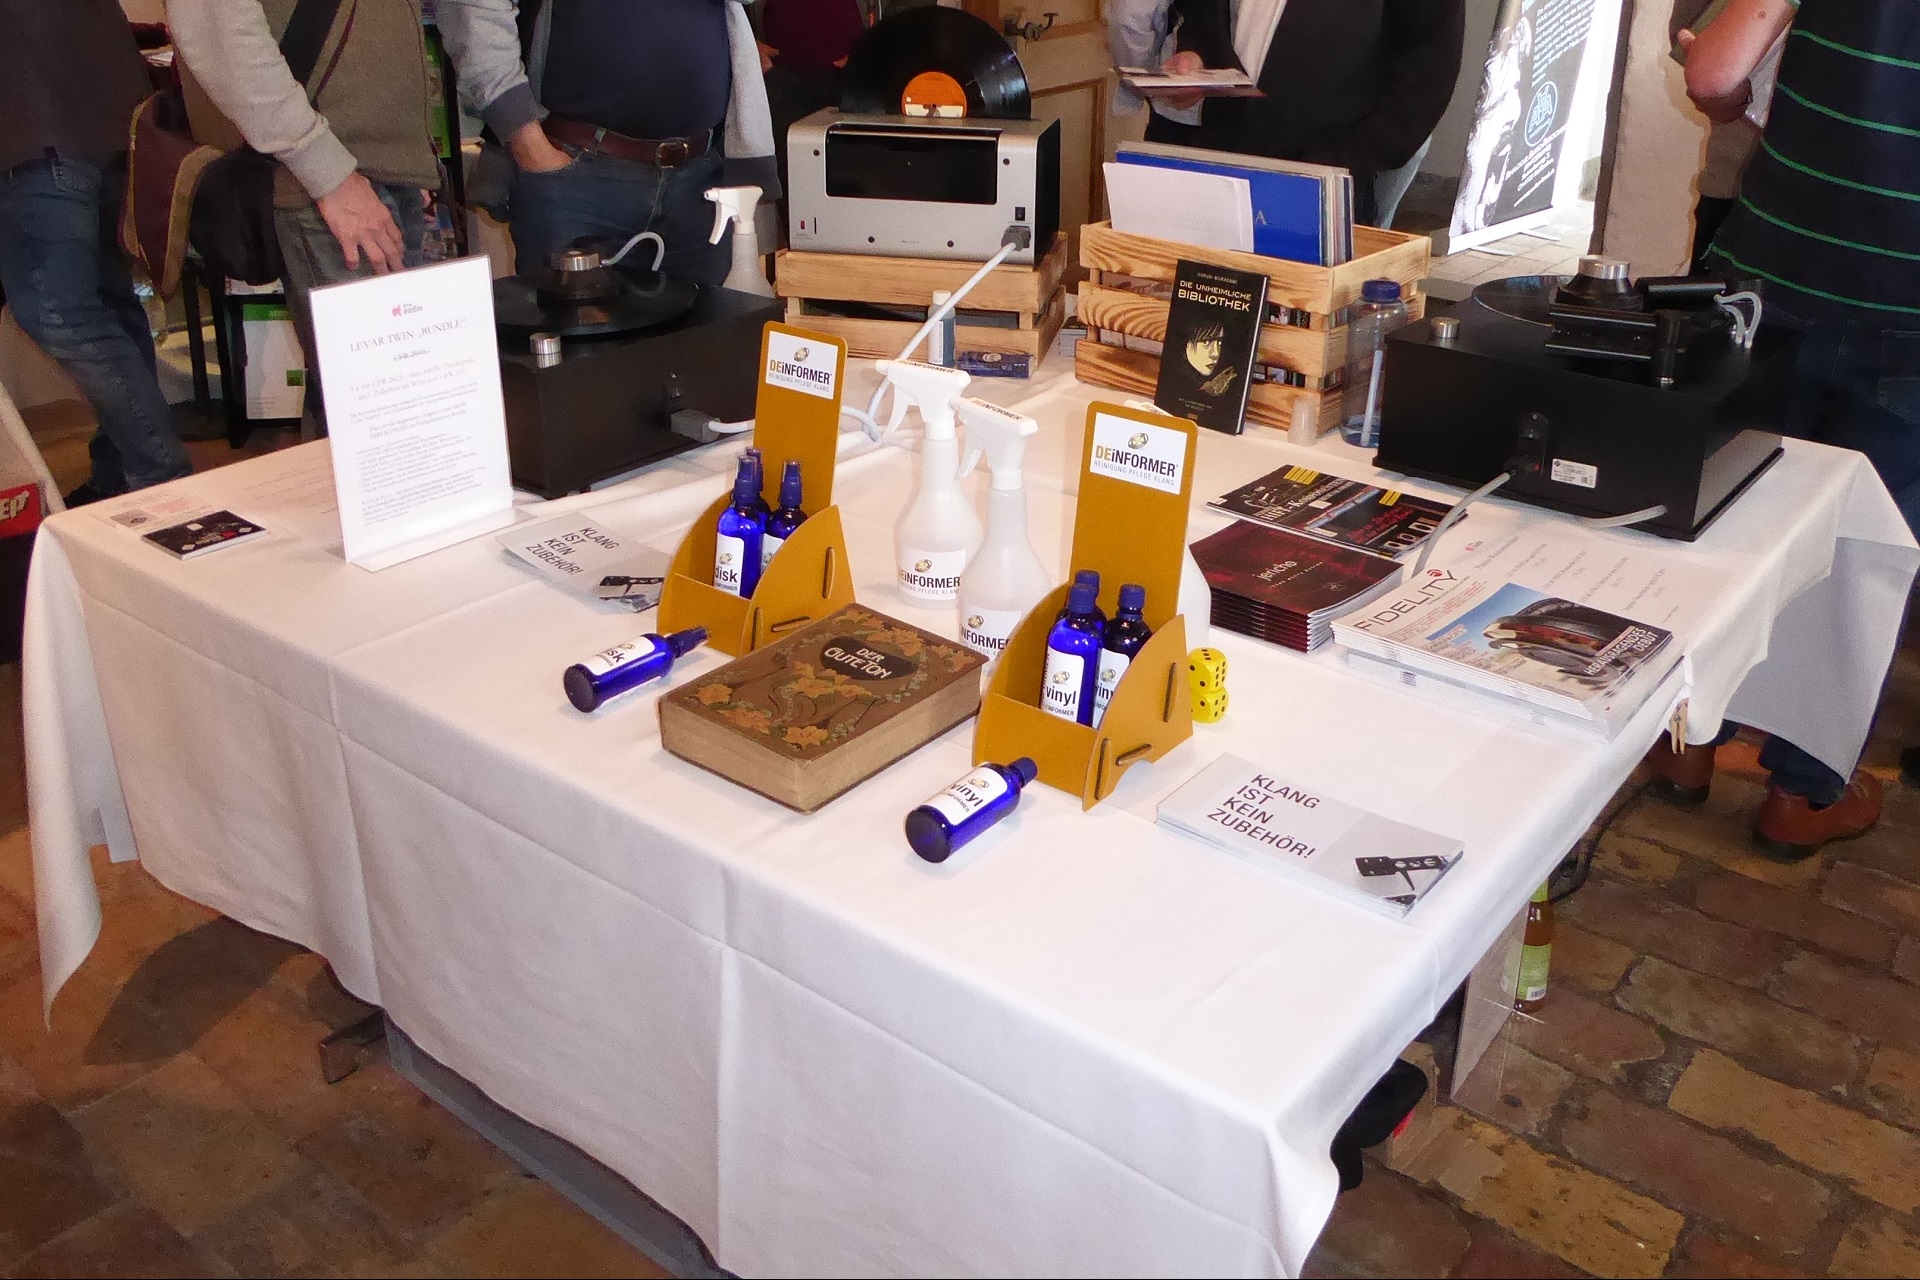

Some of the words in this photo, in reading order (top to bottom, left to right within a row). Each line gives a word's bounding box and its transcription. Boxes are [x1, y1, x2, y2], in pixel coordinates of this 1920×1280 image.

[1178, 289, 1251, 312] BIBLIOTHEK
[1179, 280, 1193, 290] DIE
[1195, 283, 1252, 301] UNHEIMLICHE
[387, 329, 415, 345] TWIN
[1093, 460, 1127, 474] REINIGUNG
[1128, 469, 1152, 480] PFLEGE
[1153, 476, 1175, 486] KLANG
[544, 538, 576, 556] KEIN
[561, 532, 587, 545] IST
[580, 526, 620, 550] KLANG
[526, 543, 585, 575] ZUBEHÖR!
[1253, 560, 1298, 582] jericho
[1353, 570, 1457, 631] FIDELITY
[824, 647, 866, 668] GUTE
[860, 660, 892, 679] TON
[856, 648, 885, 663] DER
[1046, 685, 1077, 706] vinyl
[950, 783, 984, 807] vinyl
[1236, 784, 1275, 805] IST
[1250, 773, 1321, 809] KLANG
[1222, 796, 1275, 824] KEIN
[1206, 808, 1317, 859] ZUBEHÖR!
